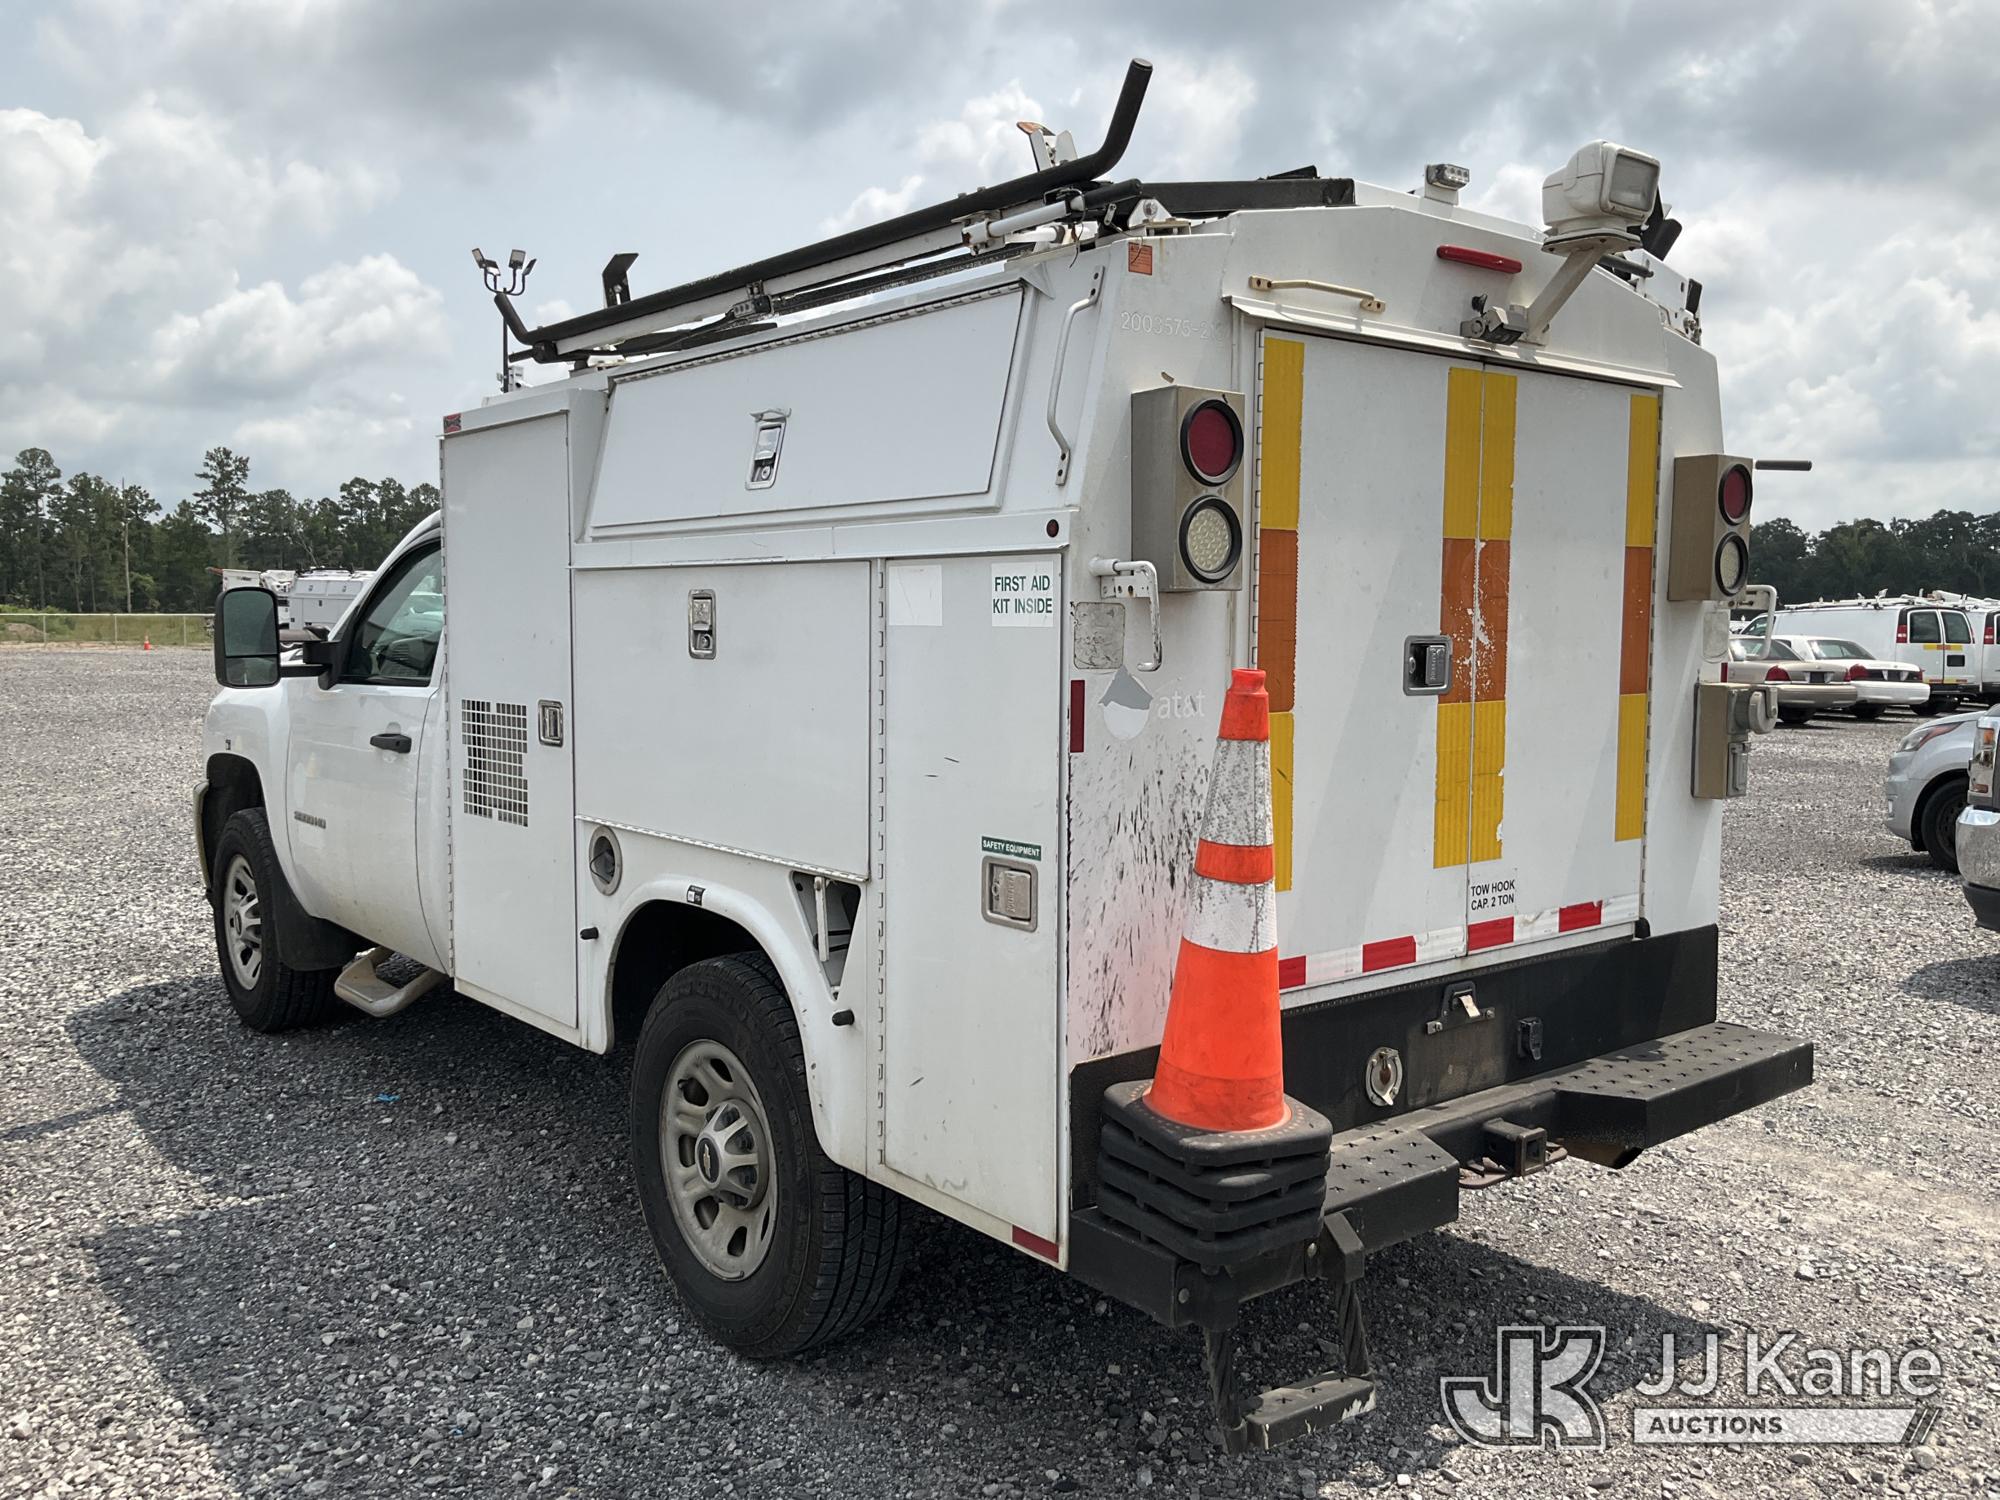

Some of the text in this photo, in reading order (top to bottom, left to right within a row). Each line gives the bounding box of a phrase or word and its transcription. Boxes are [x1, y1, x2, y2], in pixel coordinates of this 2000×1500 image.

[994, 575, 1051, 592] FIRST AID
[993, 598, 1053, 614] KIT INSIDE
[982, 840, 1041, 857] SAFETY EQUIPMENT
[1470, 879, 1515, 897] TOW HOOK
[1470, 893, 1515, 911] CAP. 2 TON
